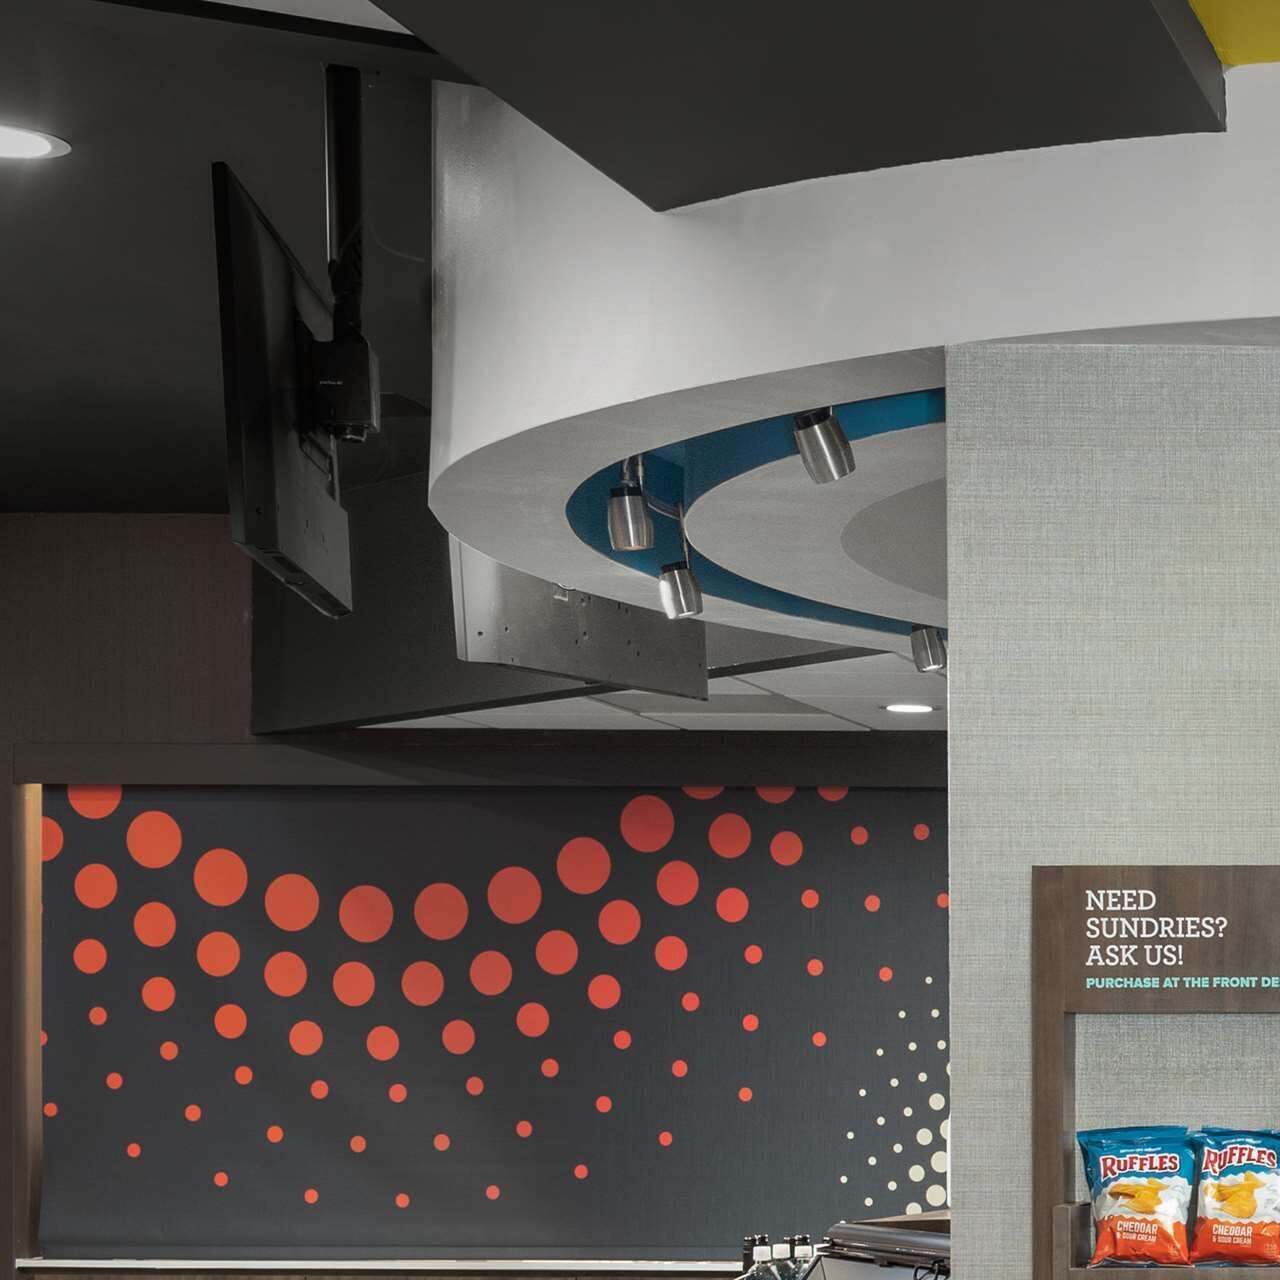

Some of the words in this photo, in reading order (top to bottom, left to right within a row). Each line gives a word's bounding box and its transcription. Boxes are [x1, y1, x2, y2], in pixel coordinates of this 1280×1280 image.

[1085, 890, 1157, 911] NEED
[1086, 917, 1228, 938] SUNDRIES?
[1085, 945, 1138, 966] ASK
[1144, 945, 1184, 966] US!
[1086, 978, 1160, 988] PURCHASE
[1163, 977, 1180, 988] AT
[1183, 977, 1209, 988] THE
[1213, 977, 1258, 988] FRONT
[1101, 1153, 1179, 1180] RUFFLES
[1202, 1145, 1278, 1176] RUFFLES
[1117, 1221, 1158, 1234] CHEDDAR
[1212, 1224, 1253, 1237] CHEDDAR
